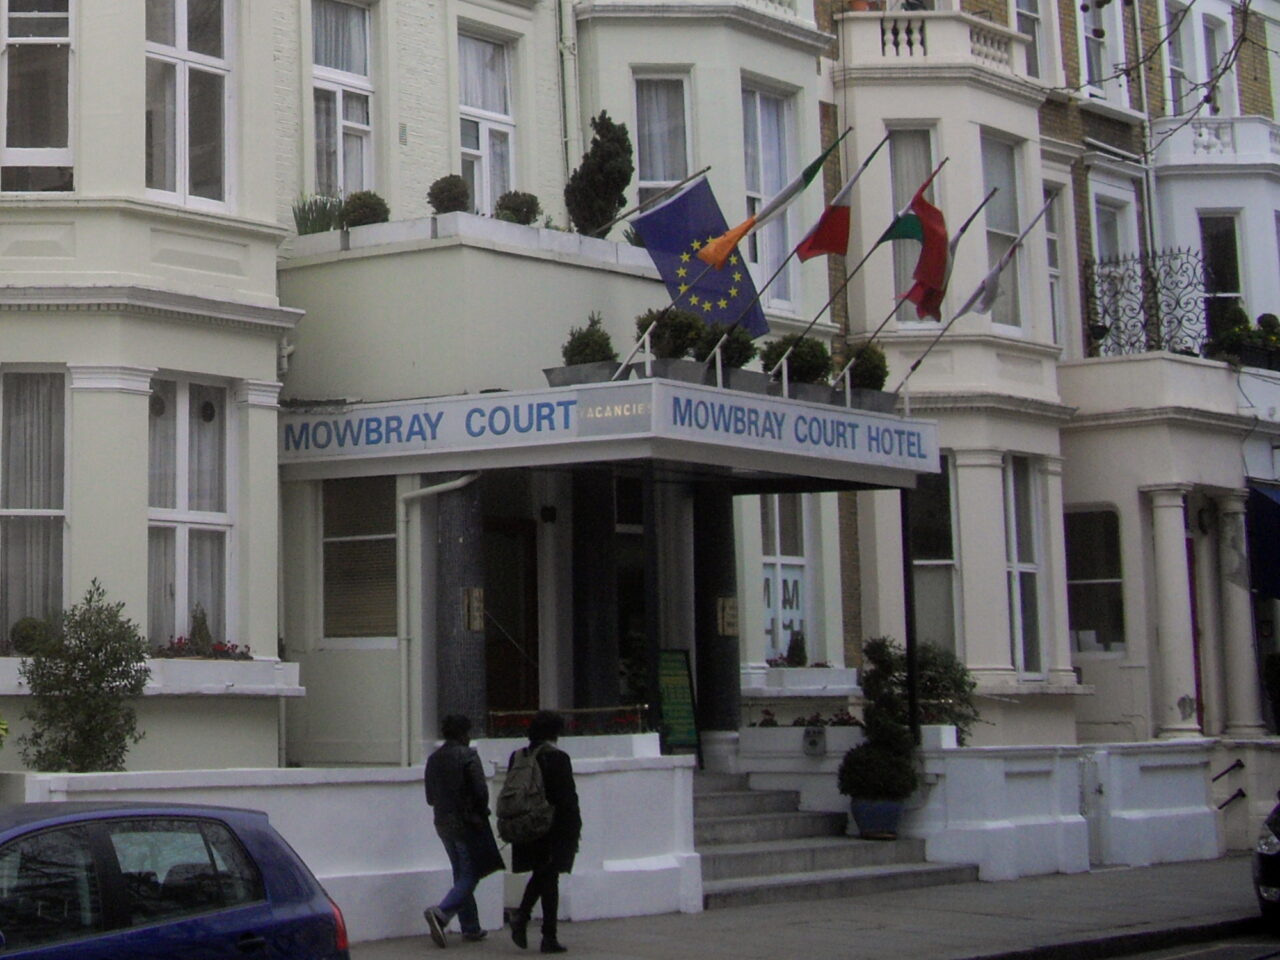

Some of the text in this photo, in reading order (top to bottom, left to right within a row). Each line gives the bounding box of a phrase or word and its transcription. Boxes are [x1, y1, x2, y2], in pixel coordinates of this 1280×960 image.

[284, 400, 577, 451] MOWBRAY COURT
[672, 396, 927, 459] MOWBRAY COURT HOTEL
